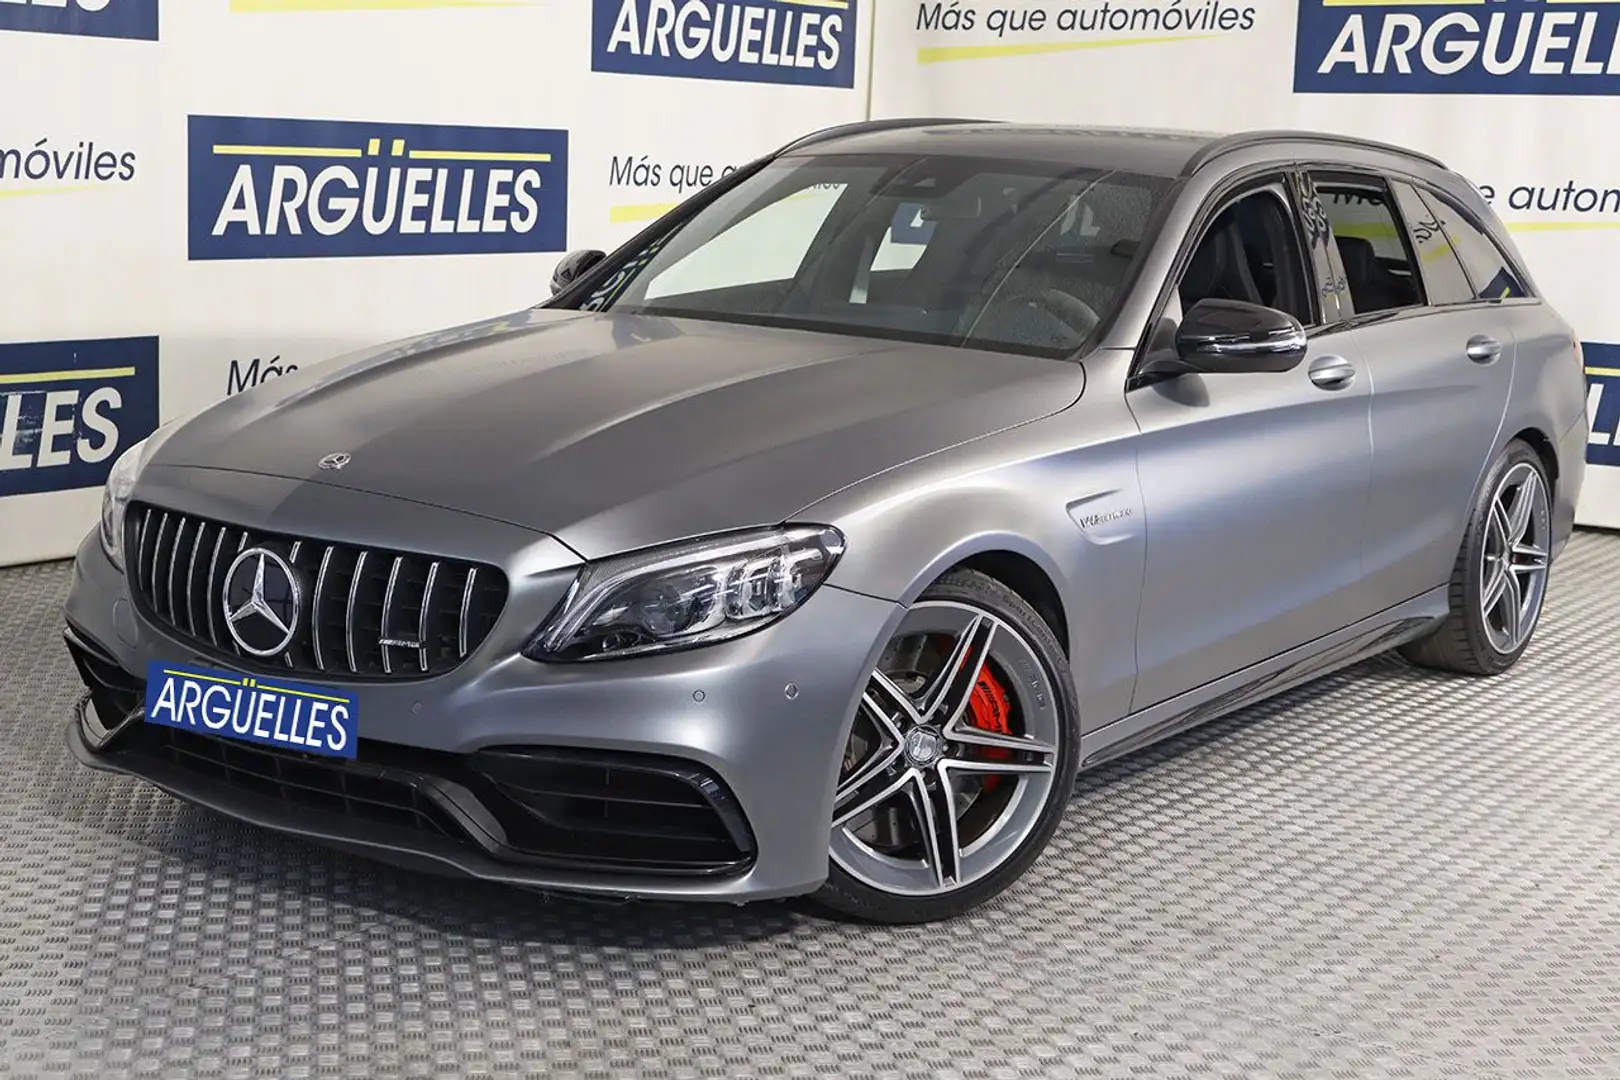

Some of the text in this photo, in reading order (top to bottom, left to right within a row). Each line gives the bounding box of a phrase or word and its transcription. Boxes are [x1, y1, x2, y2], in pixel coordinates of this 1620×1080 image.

[916, 0, 1256, 38] Más que automóviles
[211, 138, 542, 236] ARGÜELLES
[609, 155, 662, 187] Más
[669, 163, 714, 194] que
[151, 677, 350, 751] ARGÜELLES
